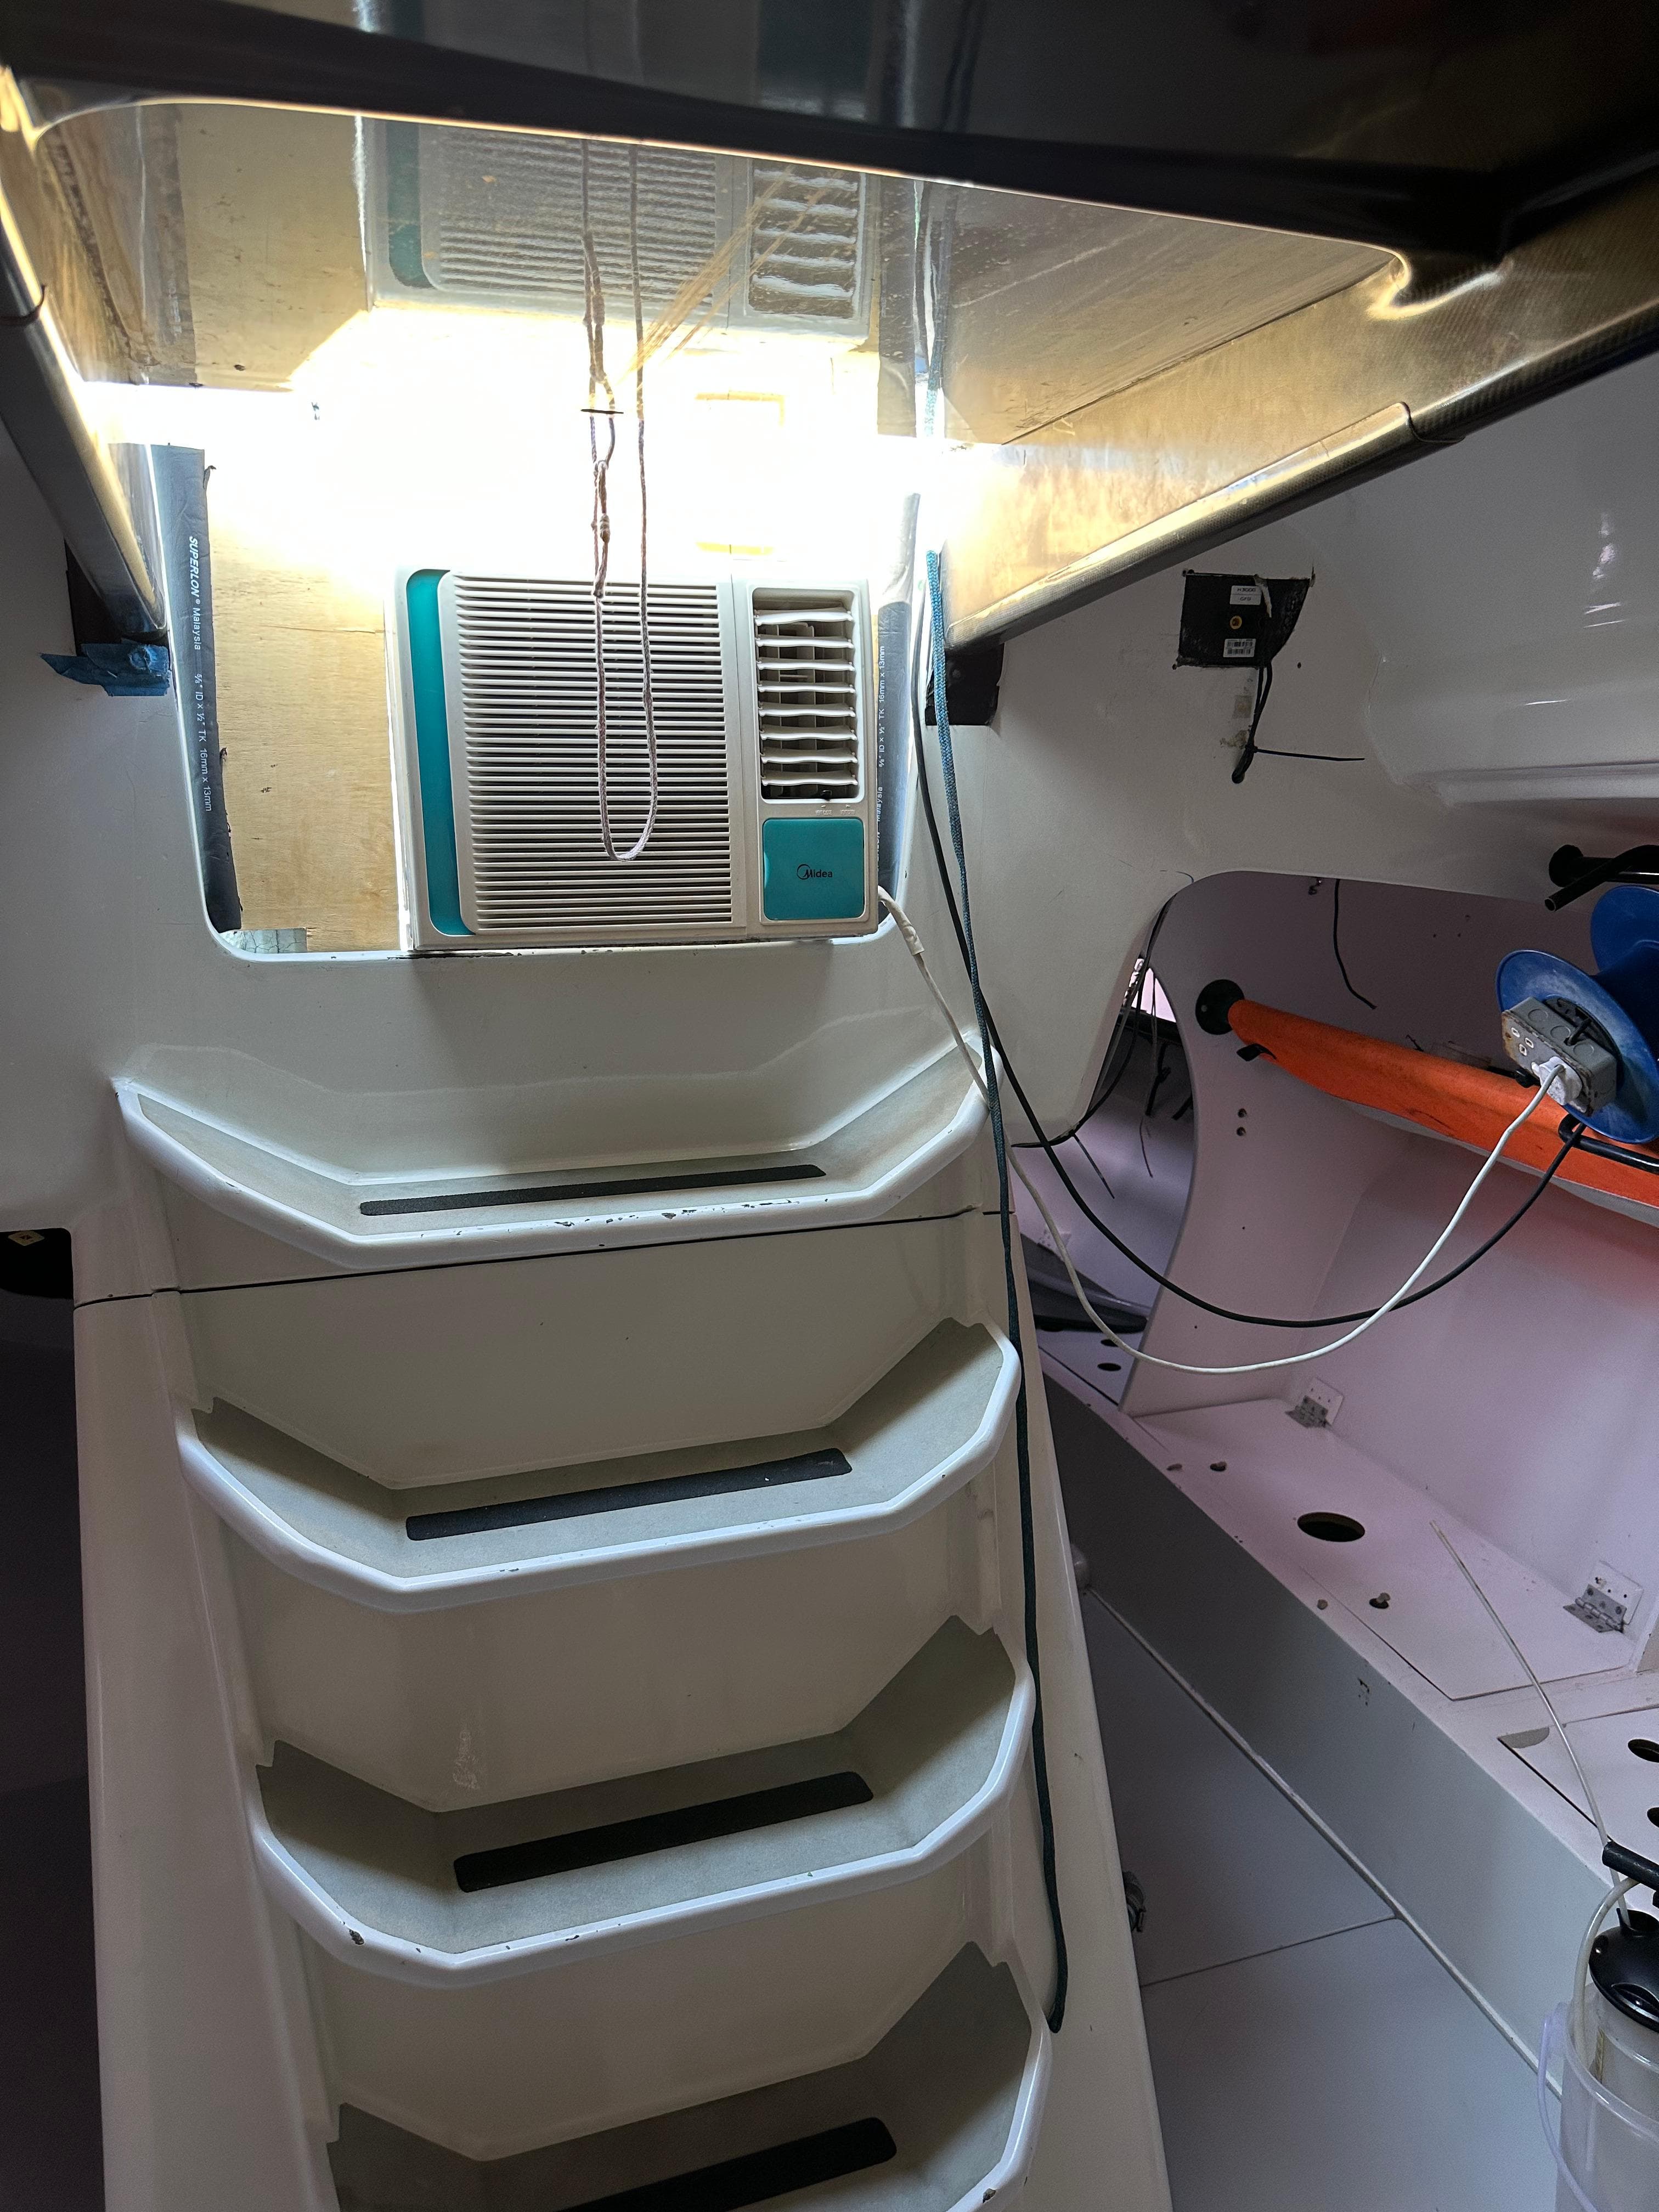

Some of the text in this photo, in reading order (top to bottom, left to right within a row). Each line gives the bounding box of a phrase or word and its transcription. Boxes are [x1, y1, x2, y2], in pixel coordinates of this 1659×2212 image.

[189, 536, 200, 597] SUPERLON
[193, 607, 202, 650] Malaysia
[195, 692, 204, 701] ID
[878, 708, 885, 720] TK
[198, 730, 207, 742] TK
[200, 748, 208, 775] 16mm
[204, 785, 212, 811] 13mm
[798, 866, 833, 879] Midea
